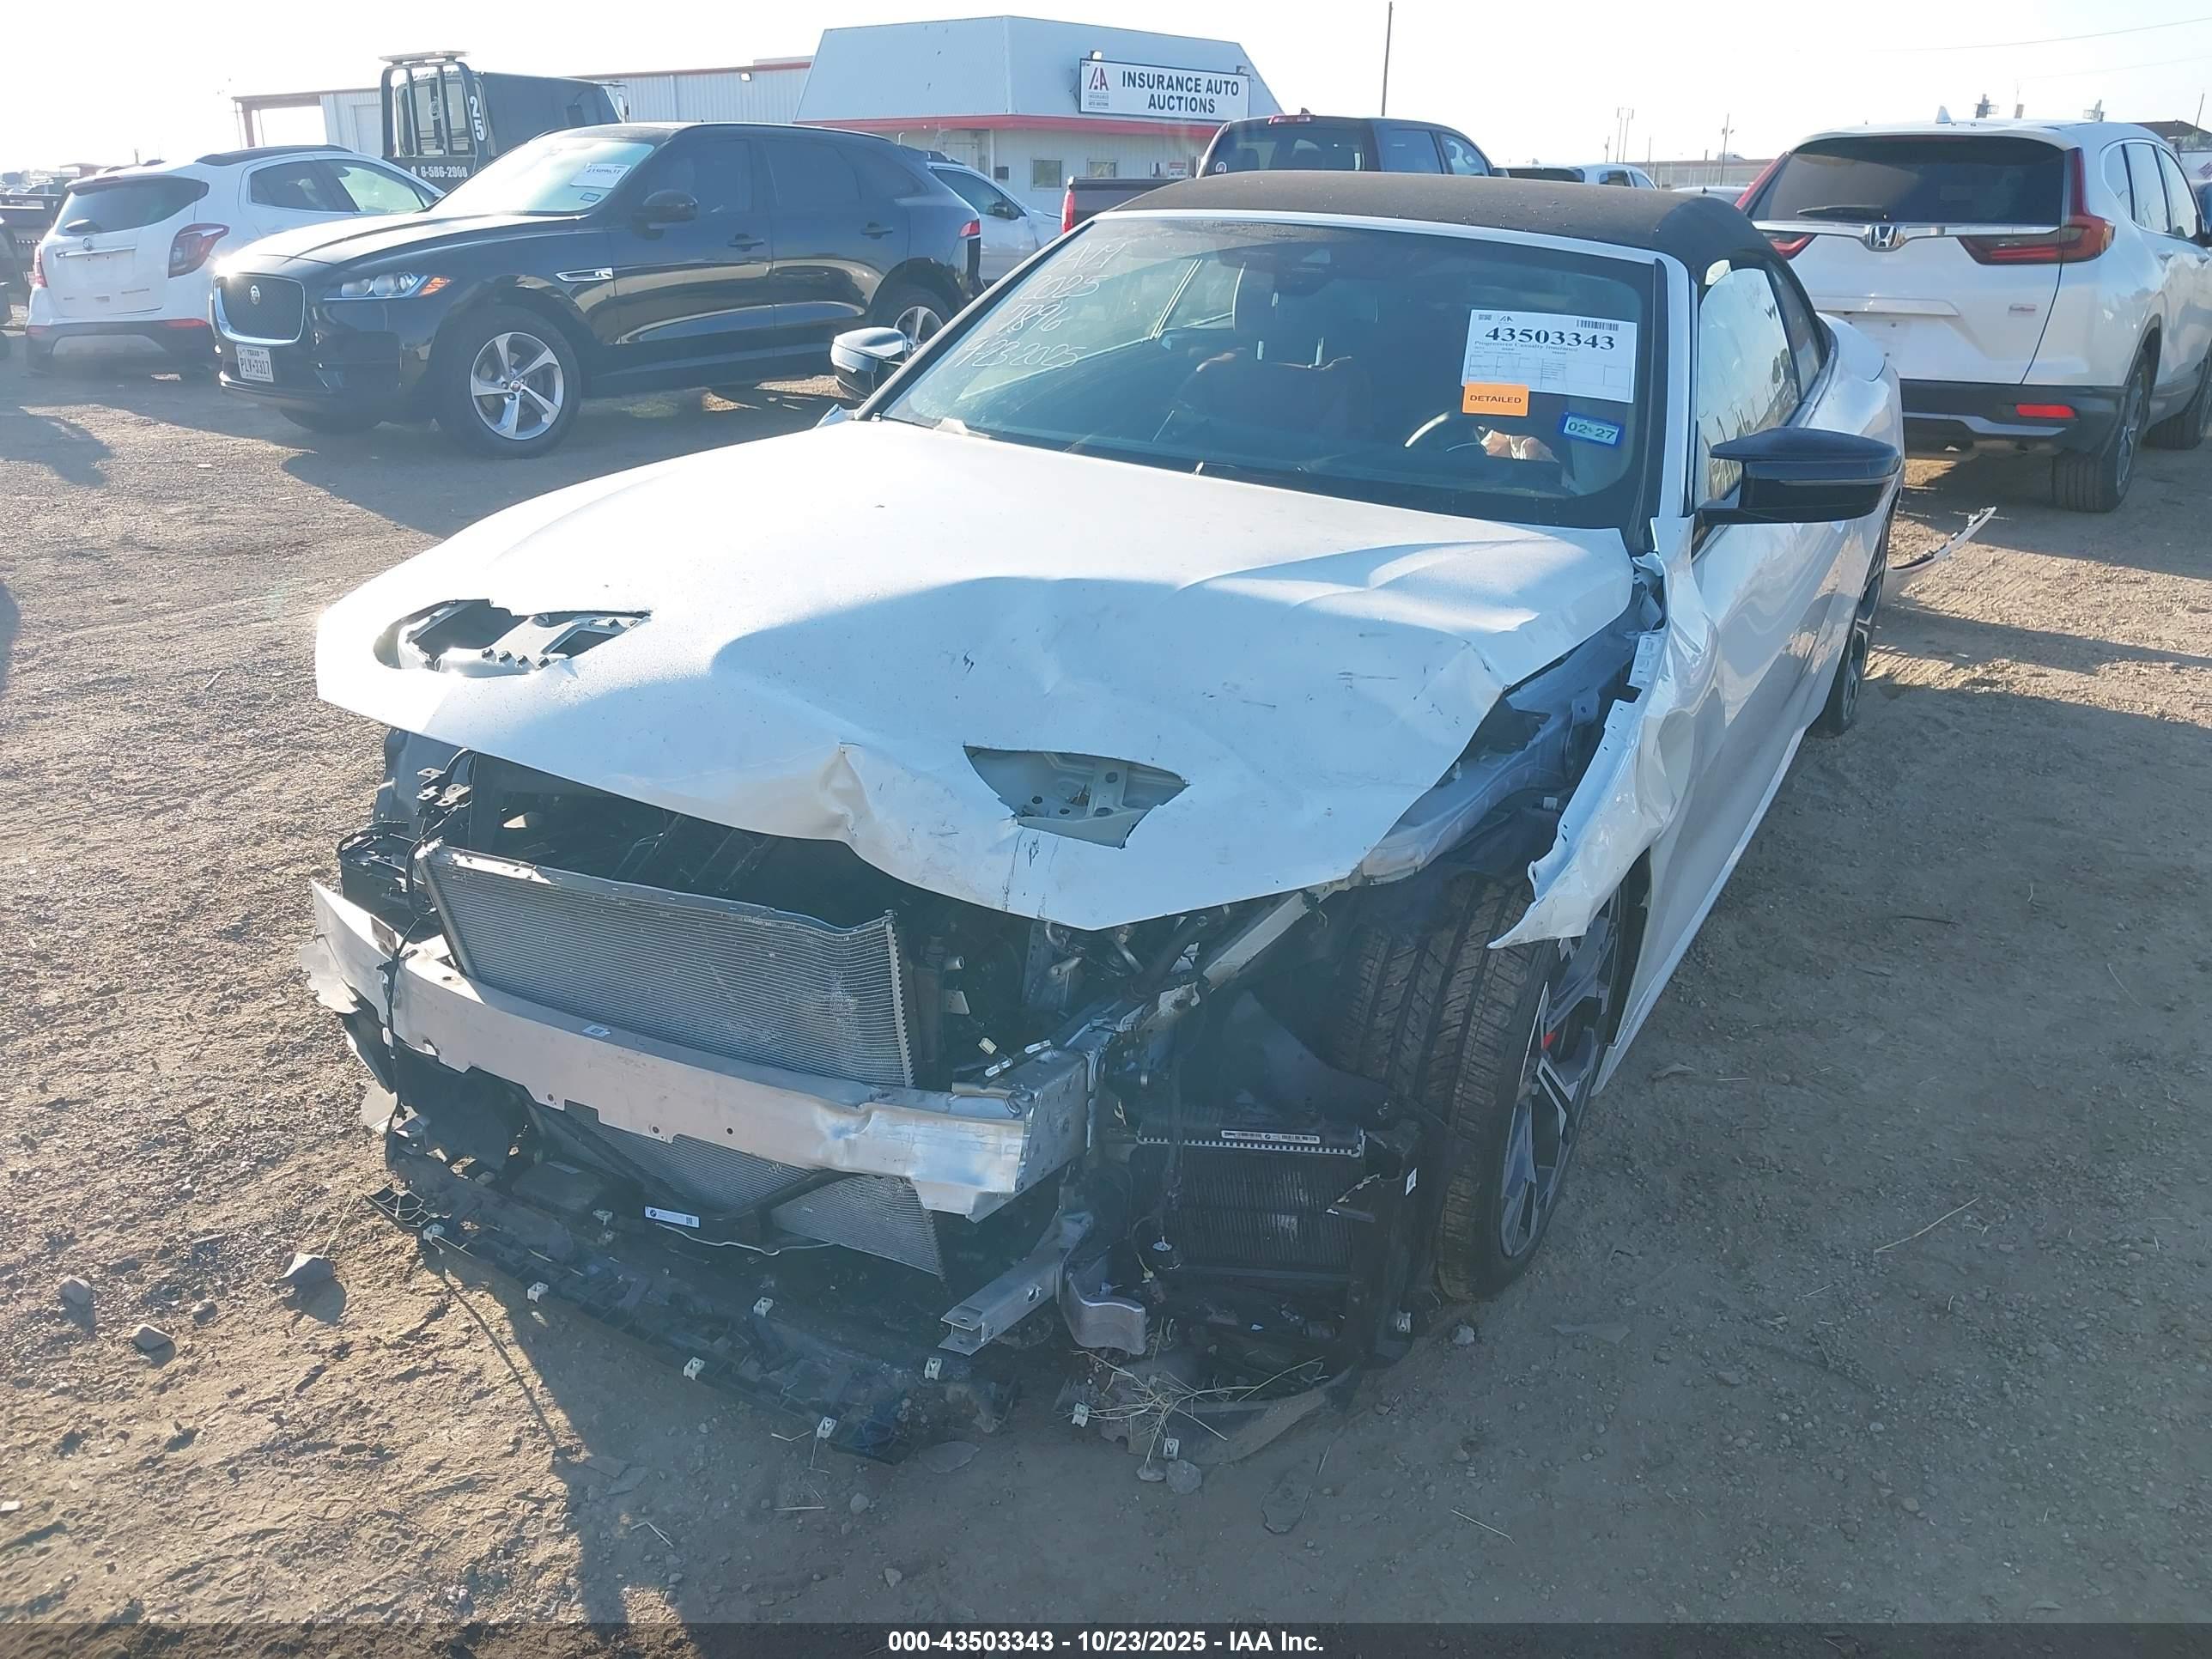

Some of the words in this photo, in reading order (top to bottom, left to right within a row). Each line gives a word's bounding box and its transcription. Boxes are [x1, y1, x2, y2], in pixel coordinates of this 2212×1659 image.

[1122, 70, 1202, 94] INSURANCE
[1205, 79, 1239, 96] AUTO
[1147, 94, 1216, 114] AUCTIONS
[1019, 275, 1109, 299] 2025
[1485, 327, 1615, 350] 43503343
[1469, 394, 1522, 404] DETAILED
